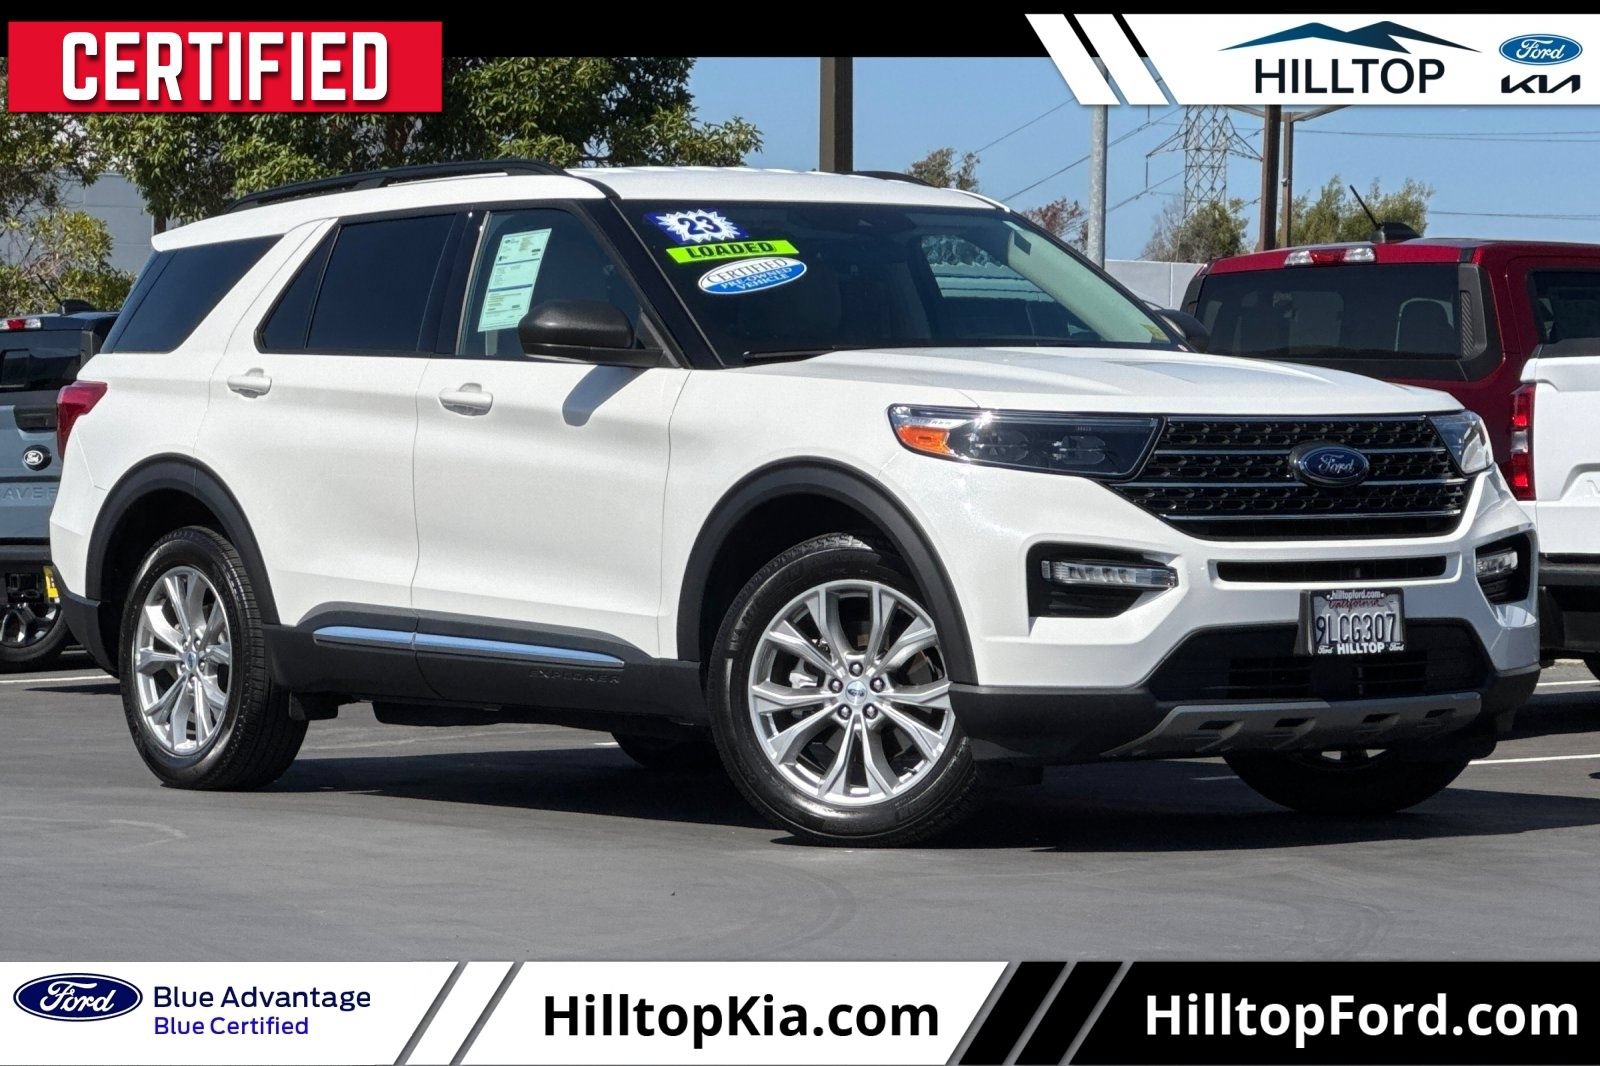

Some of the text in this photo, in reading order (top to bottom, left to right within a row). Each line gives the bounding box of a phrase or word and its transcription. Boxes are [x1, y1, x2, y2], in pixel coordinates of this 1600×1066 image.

[677, 216, 722, 235] 23
[685, 241, 775, 259] LOADED
[706, 259, 788, 284] CERTIFIED
[720, 267, 793, 289] PRE-OWNED
[735, 274, 790, 290] VEHICLE
[1318, 453, 1355, 474] Ford
[1315, 612, 1397, 644] 9LCG307
[1337, 642, 1386, 655] HILLTOP
